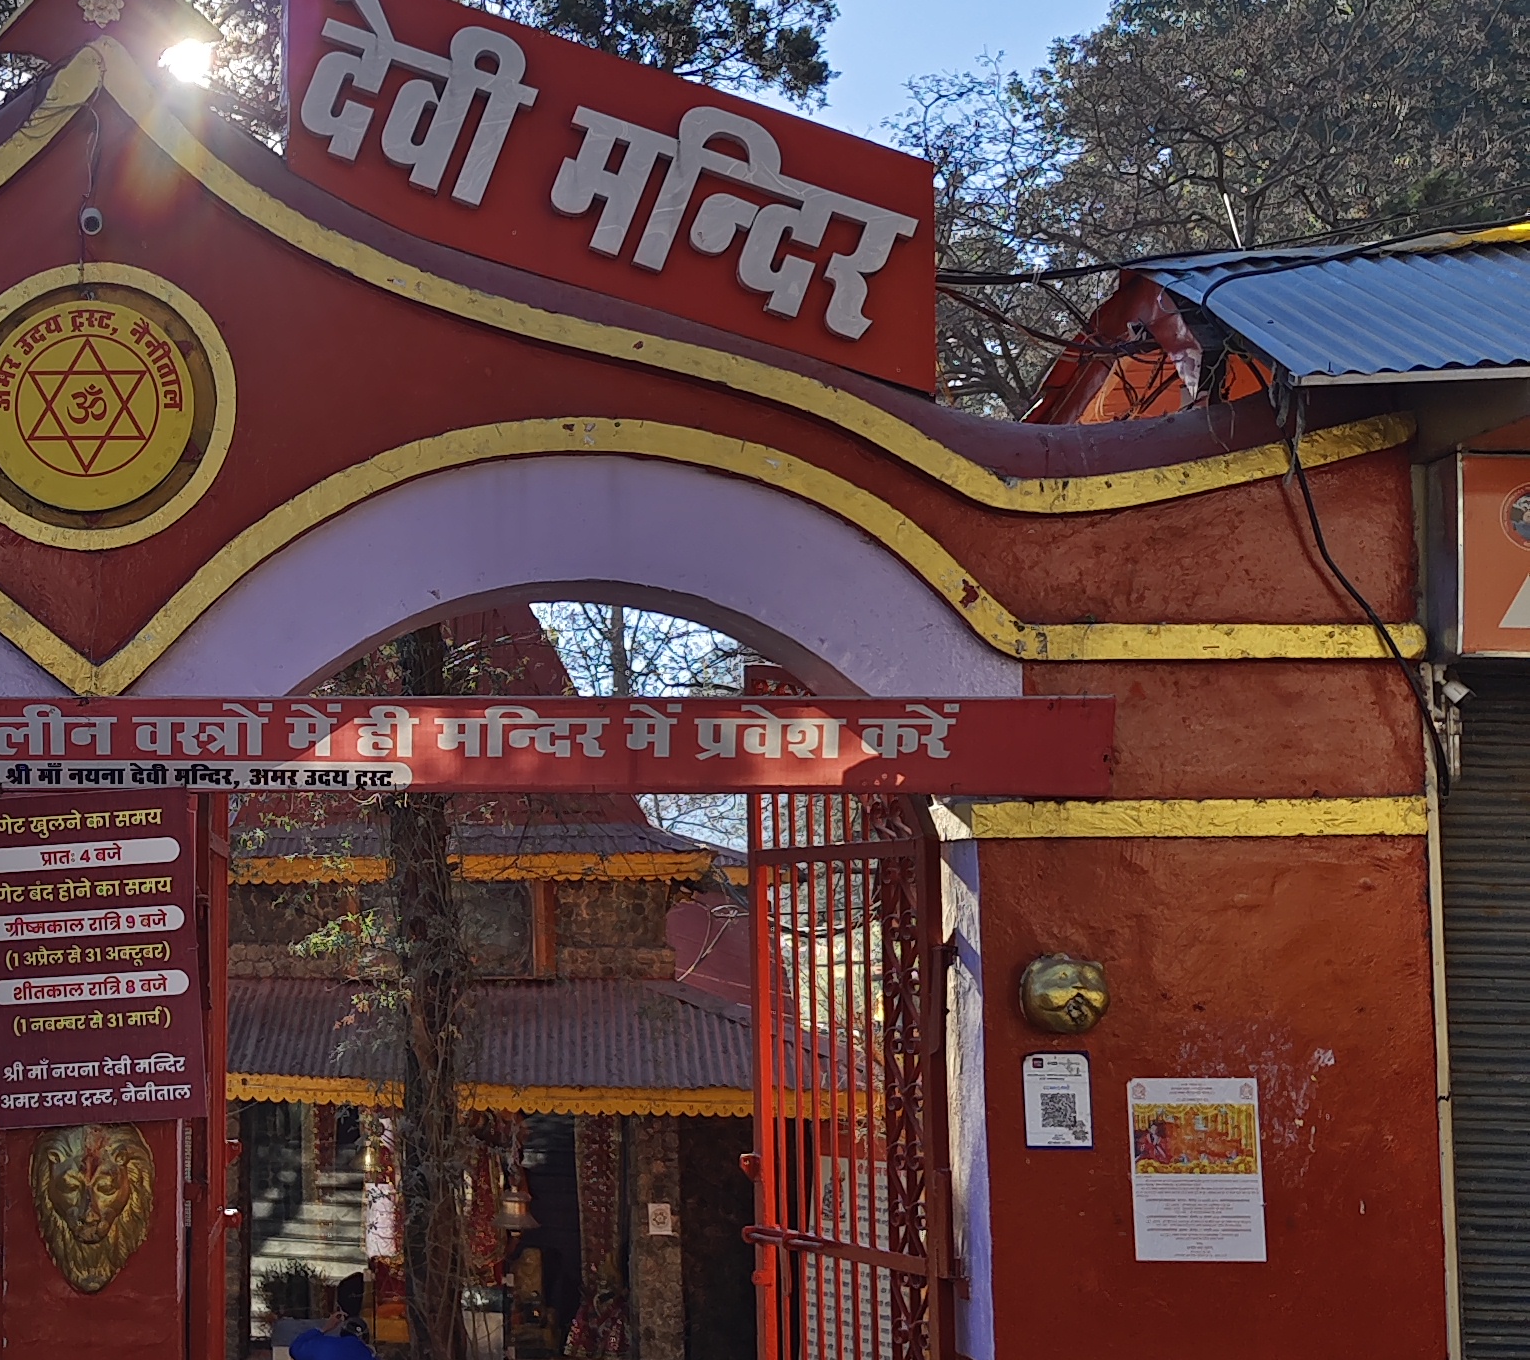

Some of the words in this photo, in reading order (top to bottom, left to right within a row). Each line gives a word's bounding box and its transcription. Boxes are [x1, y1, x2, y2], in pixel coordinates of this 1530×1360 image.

[551, 106, 919, 340] मन्दिर
[13, 314, 63, 356] उदय
[129, 317, 183, 412] नैनीताल
[133, 702, 271, 757] वस्त्रों
[285, 702, 341, 757] में
[354, 704, 420, 759] ही
[434, 706, 611, 759] मन्दिर
[623, 703, 682, 758] में
[694, 703, 847, 760] प्रवेश
[858, 702, 960, 760] करें
[5, 763, 33, 785] श्री
[68, 768, 126, 785] नयना
[129, 762, 169, 785] देवी
[249, 768, 299, 787] अमर
[304, 769, 349, 787] उदय
[355, 769, 394, 790] ट्रस्ट
[28, 809, 81, 838] खुलने
[84, 812, 111, 829] का
[113, 808, 162, 827] समय
[79, 849, 91, 863] 4
[94, 843, 122, 861] बजे
[28, 881, 54, 902] बंद
[57, 878, 91, 902] होने
[94, 880, 120, 897] का
[123, 877, 172, 895] समय
[4, 917, 84, 937] ग्रीष्मकाल
[88, 911, 121, 931] रात्रि
[125, 915, 136, 929] 9
[139, 909, 168, 927] बजे
[5, 950, 19, 970] (1
[23, 946, 63, 966] अप्रैल
[66, 945, 83, 964] से
[85, 948, 101, 962] 31
[13, 981, 84, 1001] शीतकाल
[87, 976, 121, 996] रात्रि
[125, 980, 136, 993] 8
[139, 974, 168, 992] बजे
[13, 1015, 27, 1036] (1
[88, 1010, 105, 1029] से
[107, 1013, 123, 1028] 31
[3, 1061, 24, 1082] श्री
[27, 1058, 50, 1080] माँ
[52, 1061, 100, 1079] नयना
[103, 1055, 132, 1076] देवी
[134, 1053, 186, 1073] मन्दिर
[0, 1092, 40, 1110] अमर
[42, 1090, 77, 1107] उदय
[121, 1081, 192, 1103] नैनीताल
